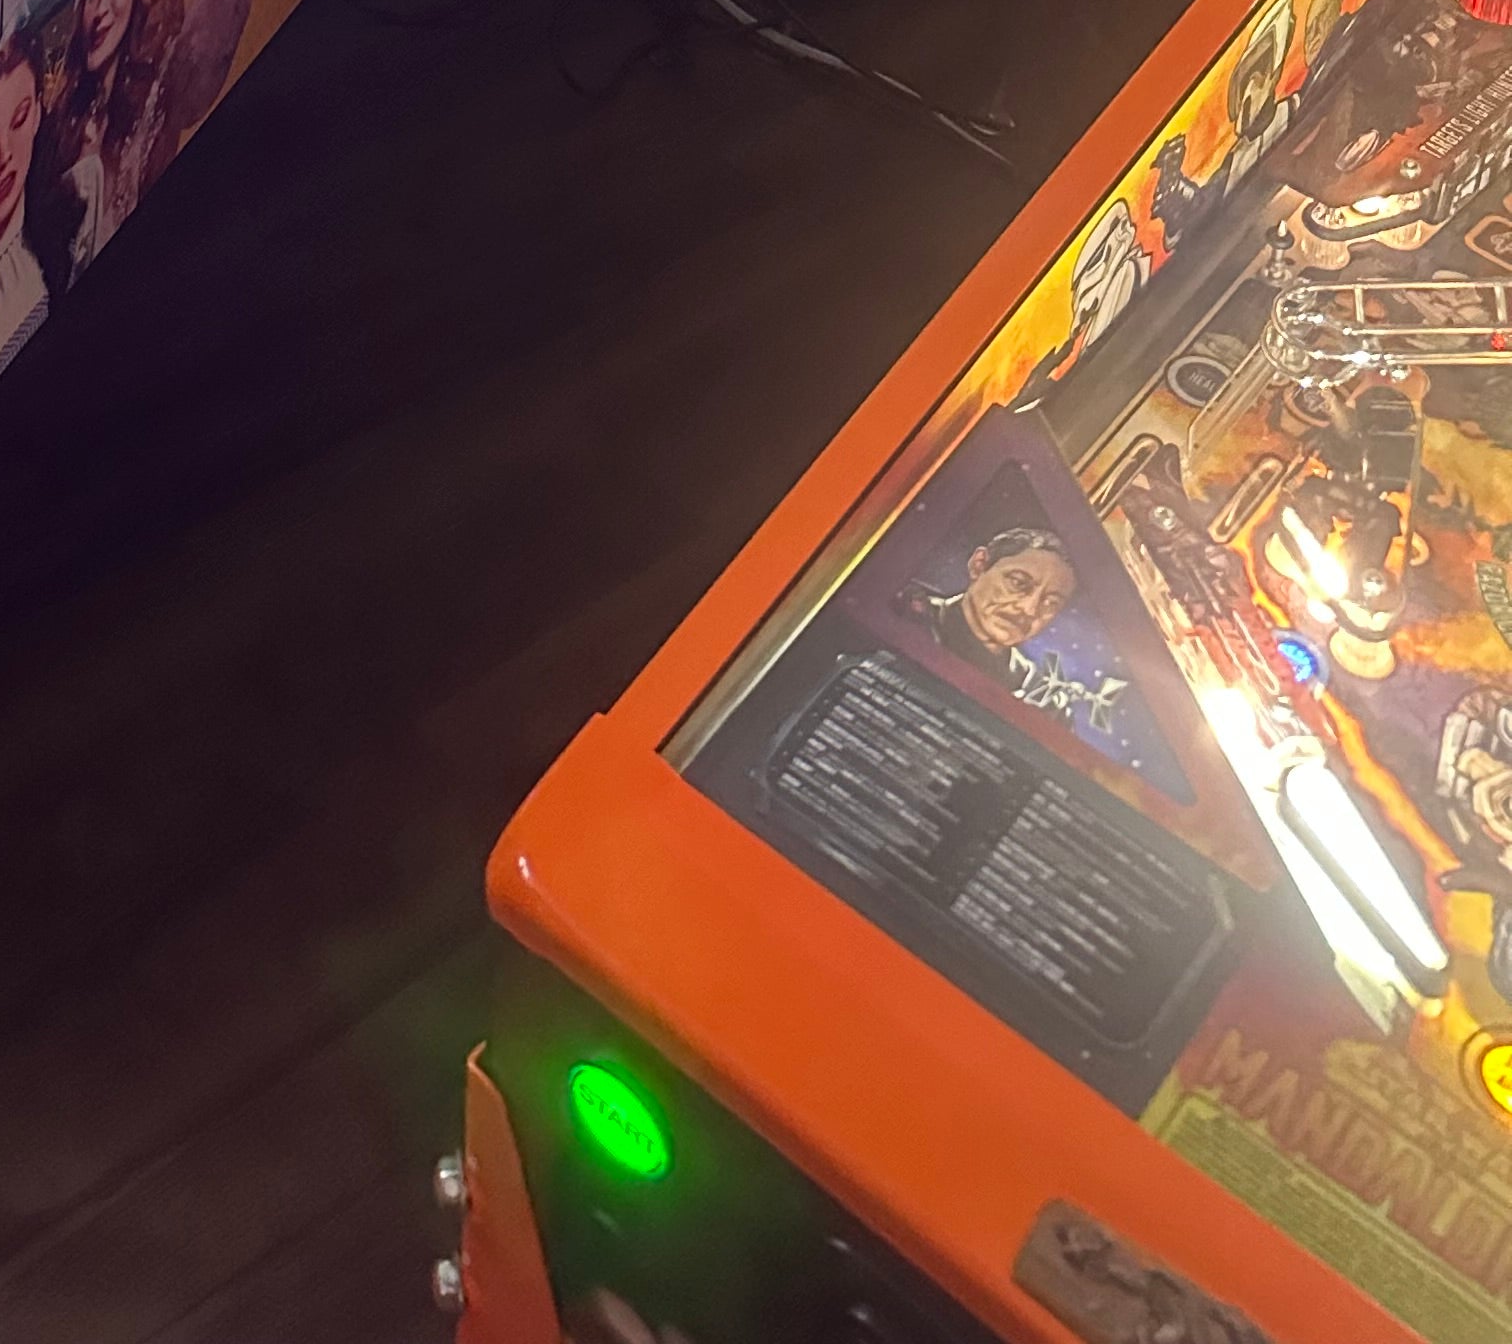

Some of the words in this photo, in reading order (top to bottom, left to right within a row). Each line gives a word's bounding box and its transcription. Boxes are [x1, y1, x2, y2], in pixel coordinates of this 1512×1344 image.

[1419, 118, 1469, 159] TARGETS
[1461, 94, 1498, 133] LIGHT
[580, 1083, 655, 1154] START
